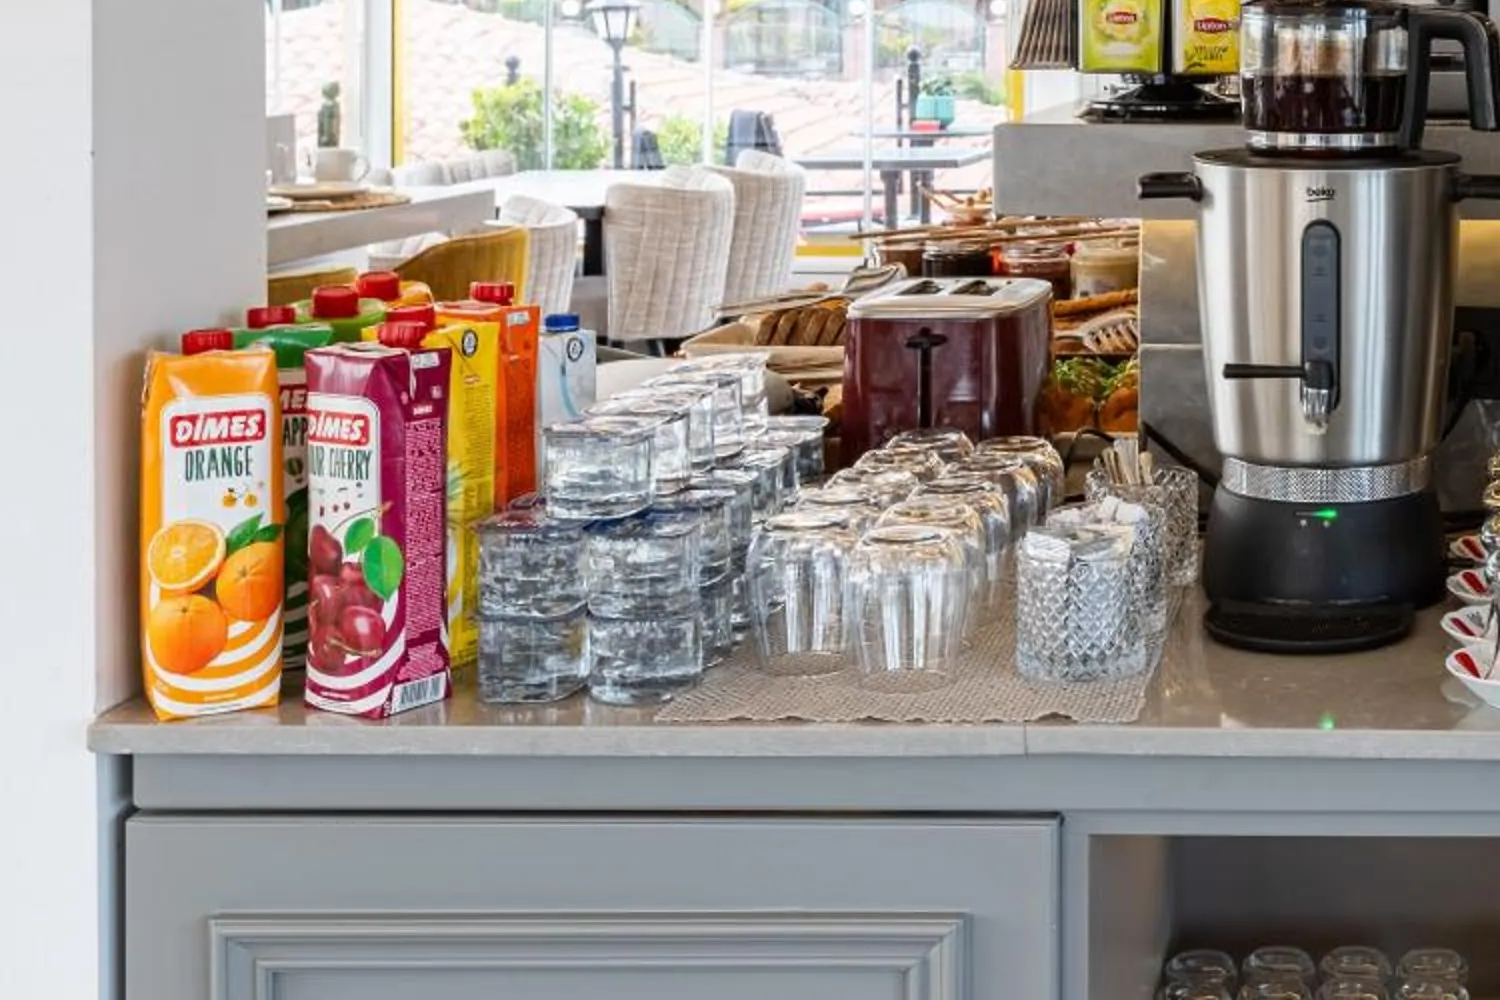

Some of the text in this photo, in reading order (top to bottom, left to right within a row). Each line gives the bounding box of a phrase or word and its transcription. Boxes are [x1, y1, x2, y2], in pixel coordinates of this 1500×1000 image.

[1197, 21, 1227, 31] Lipton
[283, 417, 308, 446] APP
[185, 446, 253, 482] ORANGE
[329, 447, 373, 481] CHERRY
